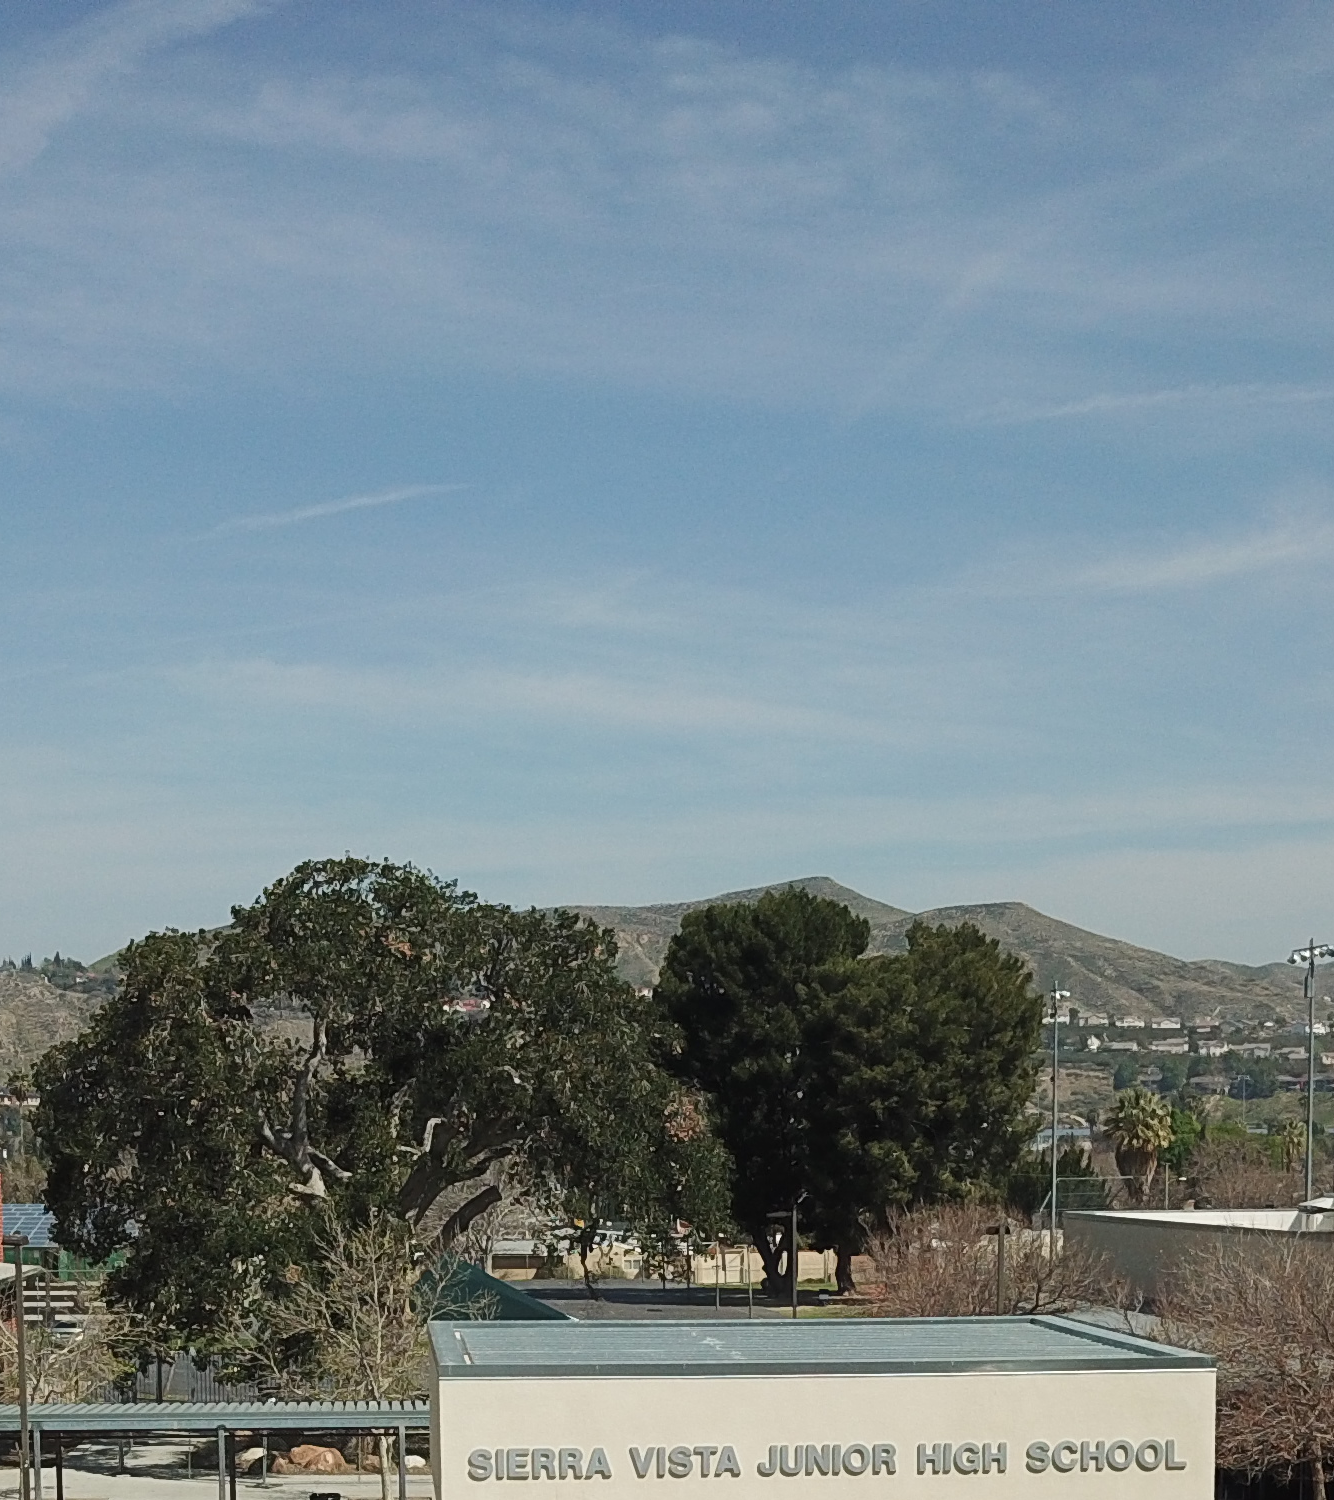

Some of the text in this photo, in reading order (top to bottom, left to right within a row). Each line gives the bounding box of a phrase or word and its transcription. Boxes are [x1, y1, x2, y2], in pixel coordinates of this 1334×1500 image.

[467, 1439, 1187, 1481] SIERRA VISTA JUNIOR HIGH SCHOOL
